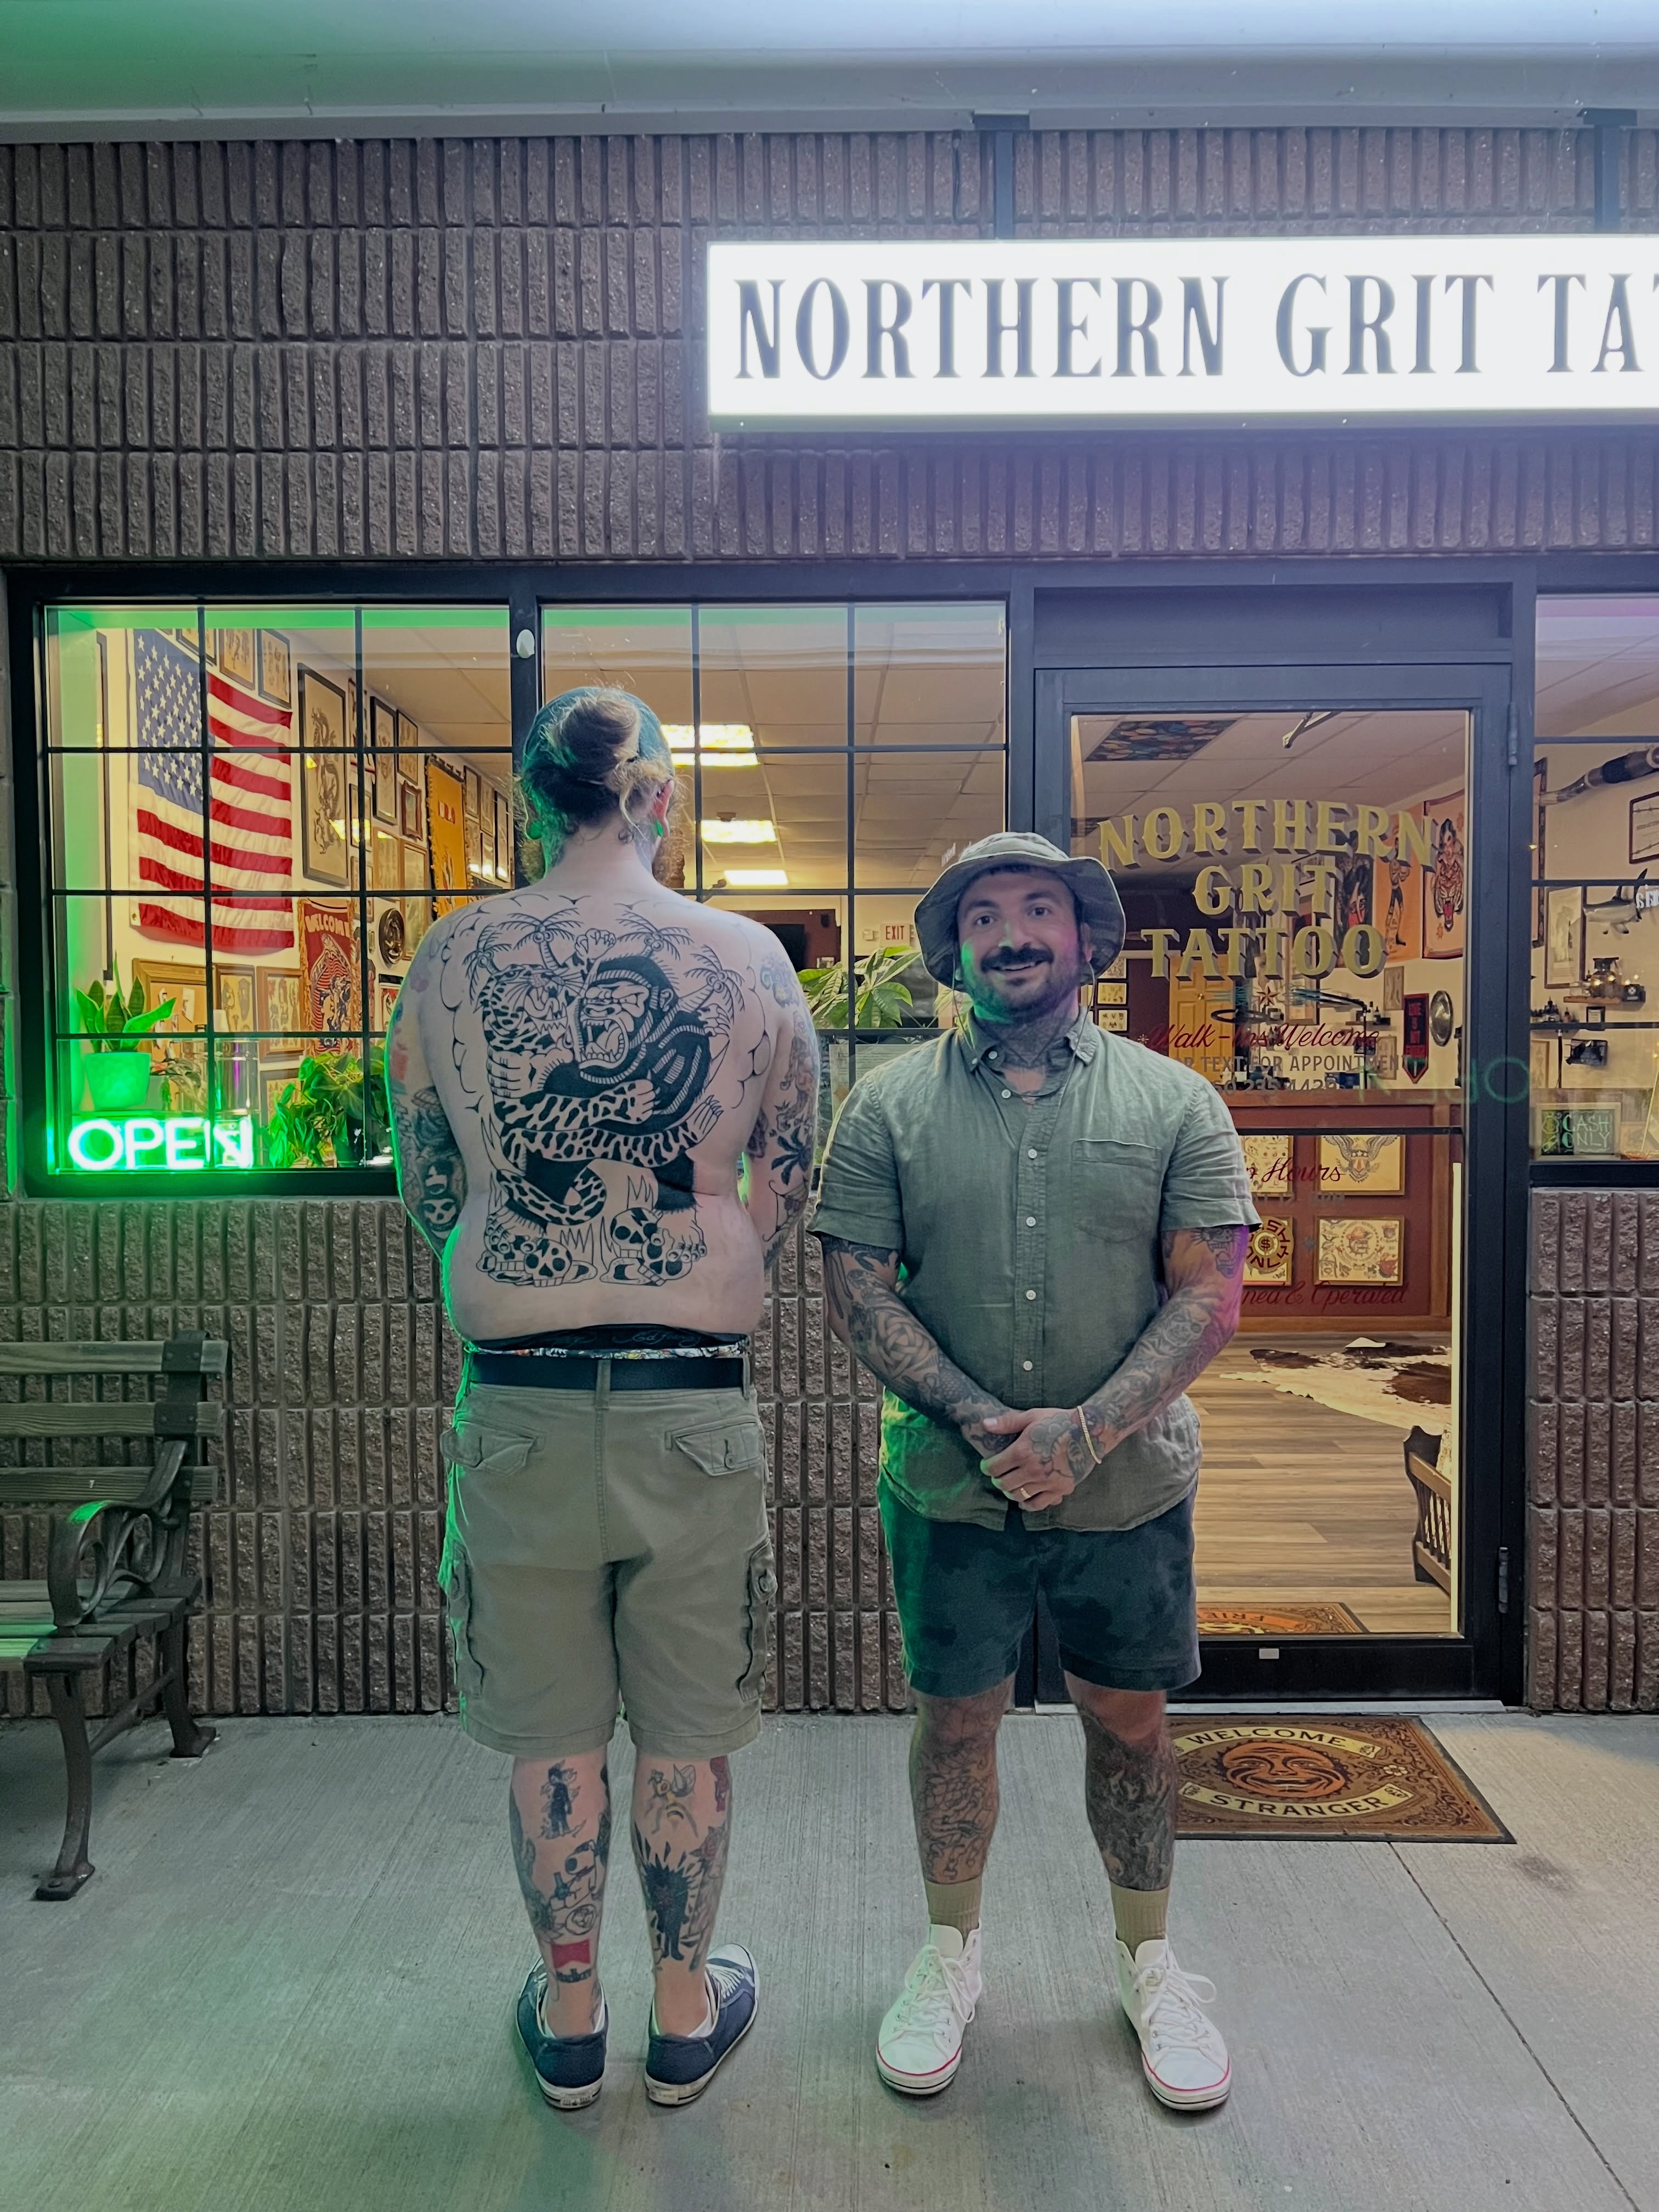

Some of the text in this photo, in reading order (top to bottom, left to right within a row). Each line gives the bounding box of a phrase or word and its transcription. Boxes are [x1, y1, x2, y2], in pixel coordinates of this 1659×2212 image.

[733, 275, 1231, 381] NORTHERN
[1276, 273, 1494, 377] GRIT
[1098, 799, 1439, 872] NORTHERN
[1192, 863, 1344, 919] GRIT
[885, 926, 905, 940] EXIT
[1141, 923, 1389, 980] TATTOO
[1276, 1023, 1380, 1051] Welcome
[1200, 1056, 1244, 1072] TEXT
[1249, 1055, 1283, 1071] FOR
[1562, 1114, 1610, 1132] CASH
[68, 1116, 253, 1170] OPEN
[1562, 1131, 1611, 1148] ONLY
[1262, 1156, 1346, 1183] Hours
[1242, 1282, 1285, 1305] ned
[1311, 1280, 1410, 1313] Operated
[1197, 1611, 1265, 1622] FRIE
[1187, 1728, 1346, 1748] WELCOME
[1210, 1794, 1390, 1818] STRANGER
